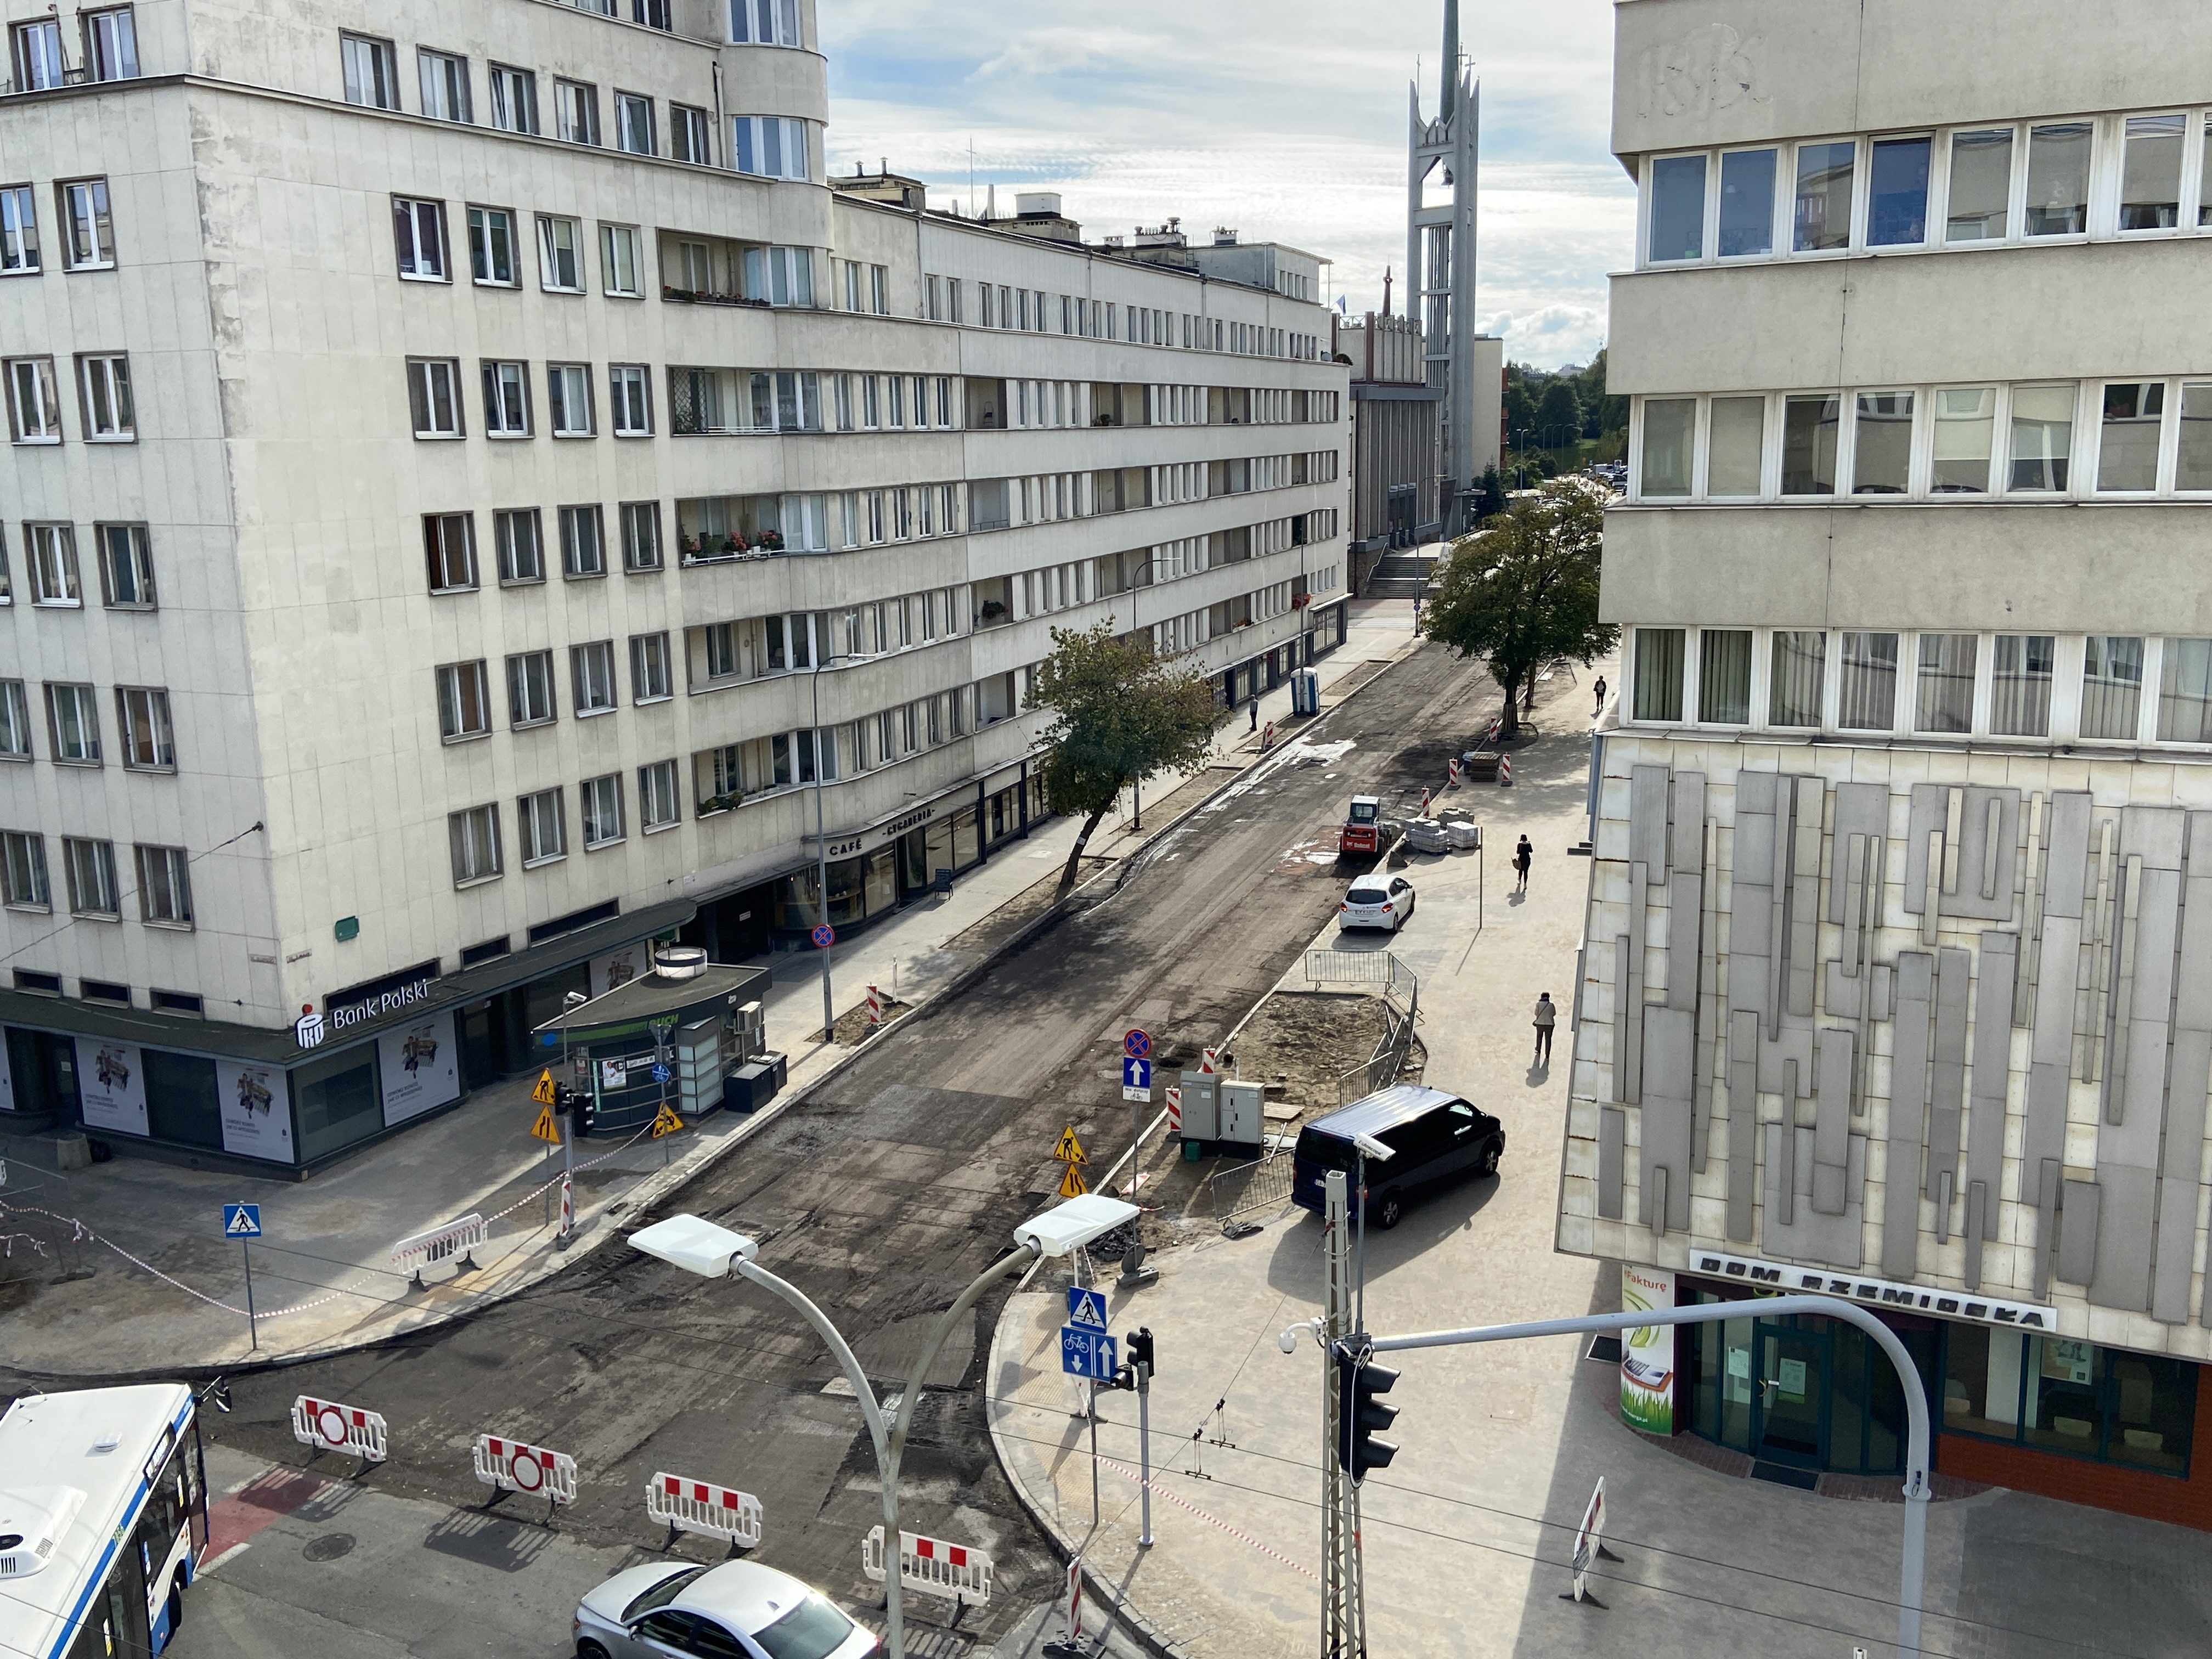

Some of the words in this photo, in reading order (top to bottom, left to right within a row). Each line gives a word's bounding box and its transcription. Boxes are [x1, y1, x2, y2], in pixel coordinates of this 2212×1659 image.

[829, 837, 862, 856] CAFÉ
[333, 998, 376, 1029] Bank
[380, 978, 428, 1013] Polski
[1700, 1257, 1781, 1283] DOM
